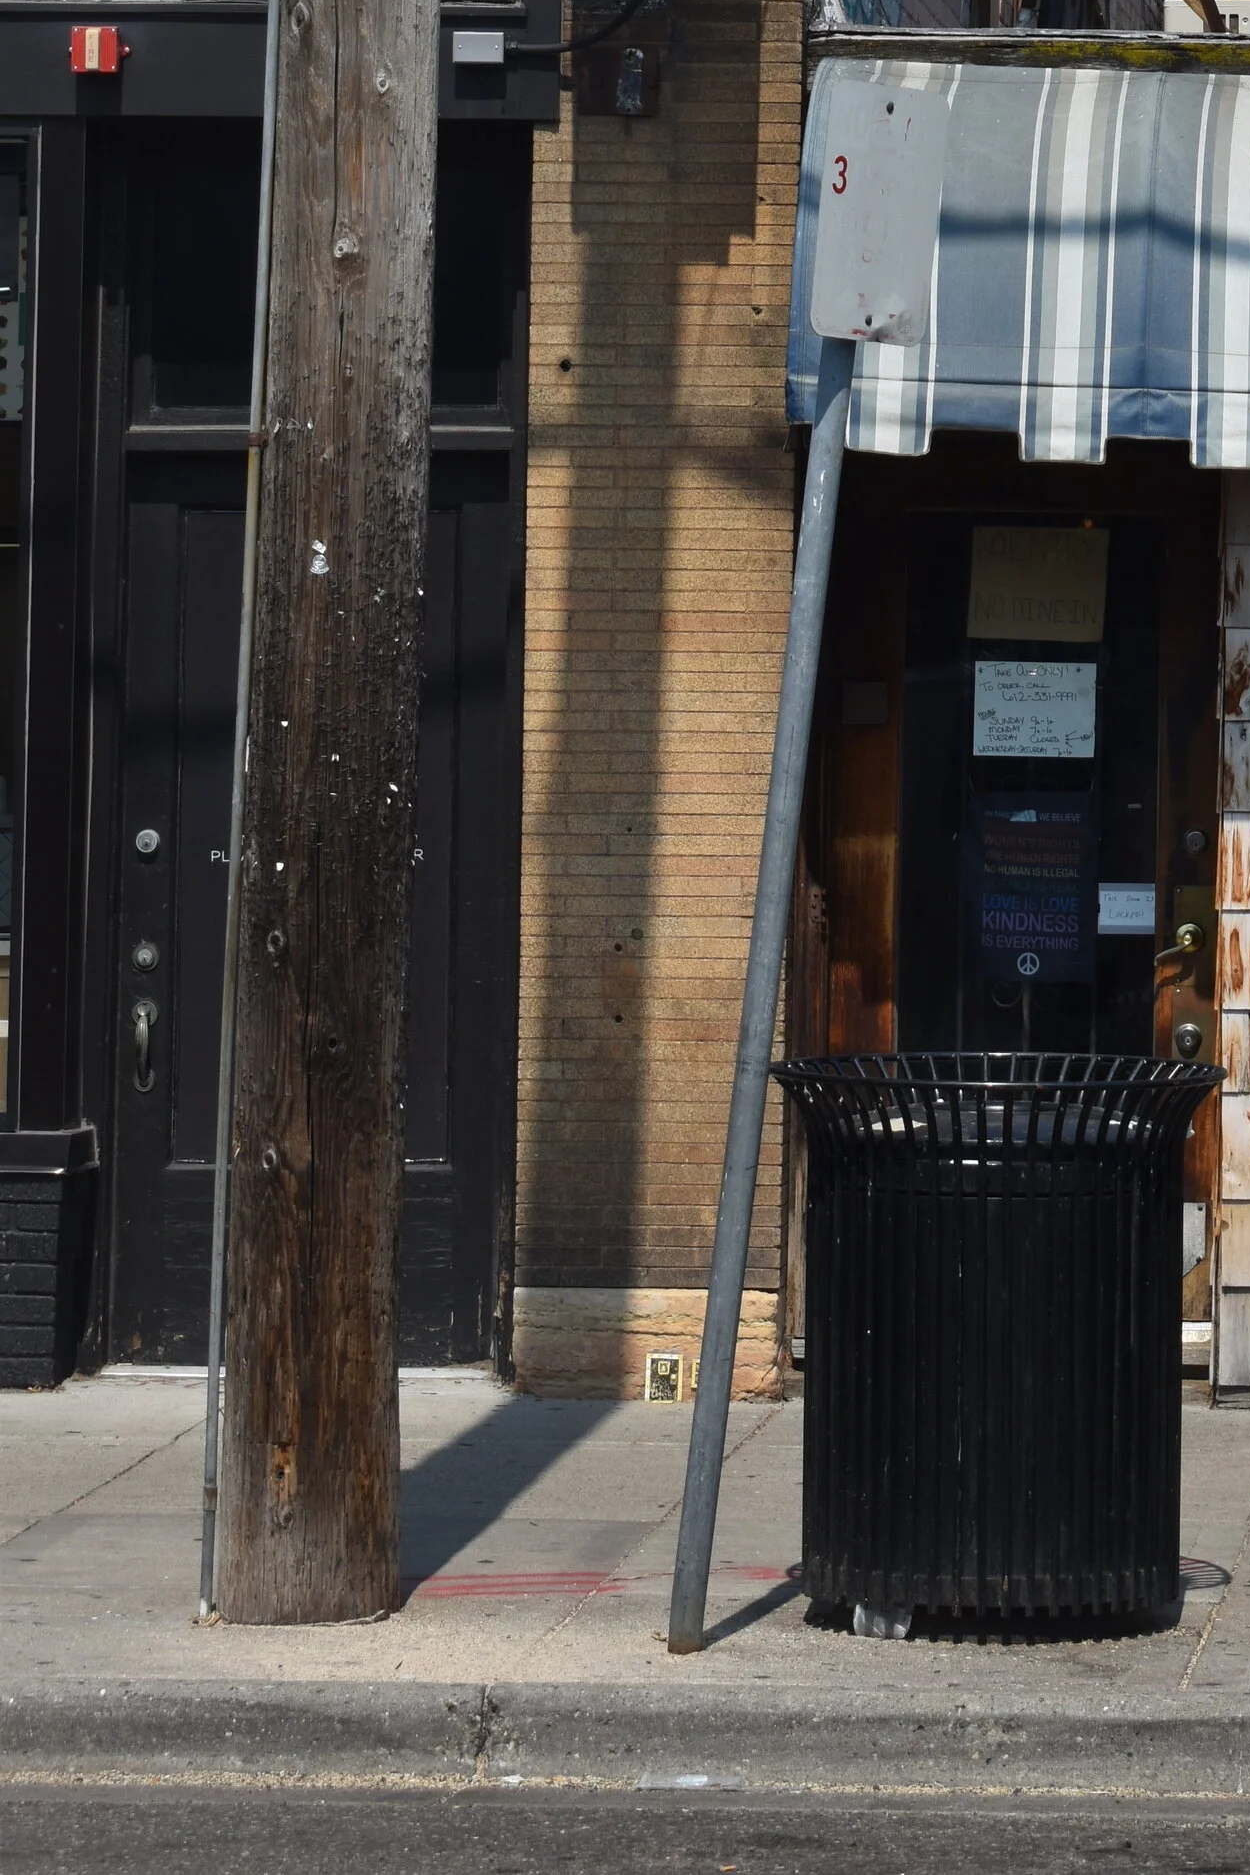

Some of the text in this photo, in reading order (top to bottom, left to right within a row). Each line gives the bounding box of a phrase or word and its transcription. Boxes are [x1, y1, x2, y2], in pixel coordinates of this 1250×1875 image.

[832, 155, 848, 195] 3
[974, 591, 1005, 624] NO
[984, 863, 1080, 878] NO HUMAN IS ILLEGAL
[983, 893, 1021, 911] LOVE
[1041, 897, 1080, 913] LOVE
[983, 910, 1080, 933] KINDNESS
[981, 932, 1080, 951] IS EVERYTHING
